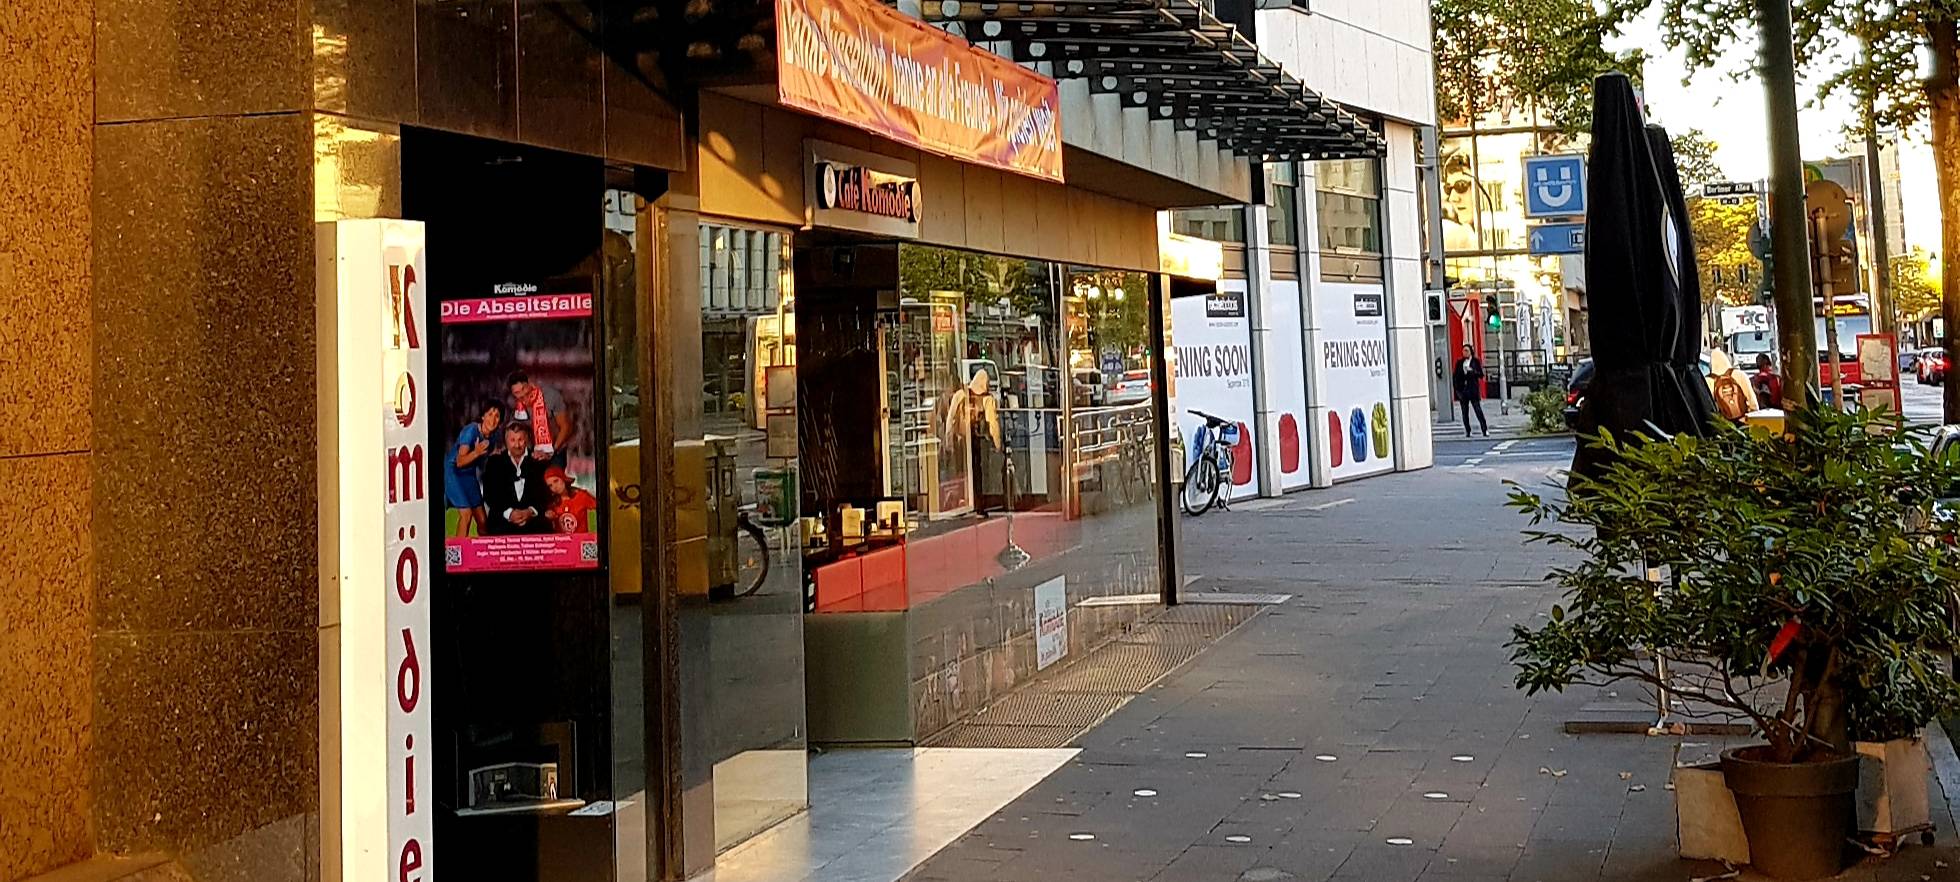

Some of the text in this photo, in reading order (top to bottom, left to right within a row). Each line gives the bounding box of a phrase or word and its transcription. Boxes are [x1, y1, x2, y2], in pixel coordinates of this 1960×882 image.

[891, 36, 925, 112] danke
[925, 63, 938, 117] an
[938, 56, 955, 123] alle
[955, 61, 991, 133] Freunde
[838, 166, 911, 219] Café Komödie
[1536, 166, 1573, 208] U
[1706, 183, 1751, 194] Berliner Allee
[493, 283, 538, 295] Komödie
[440, 295, 593, 317] Die Abseitsfalle
[1214, 344, 1249, 379] SOON
[1323, 338, 1386, 369] PENING SOON
